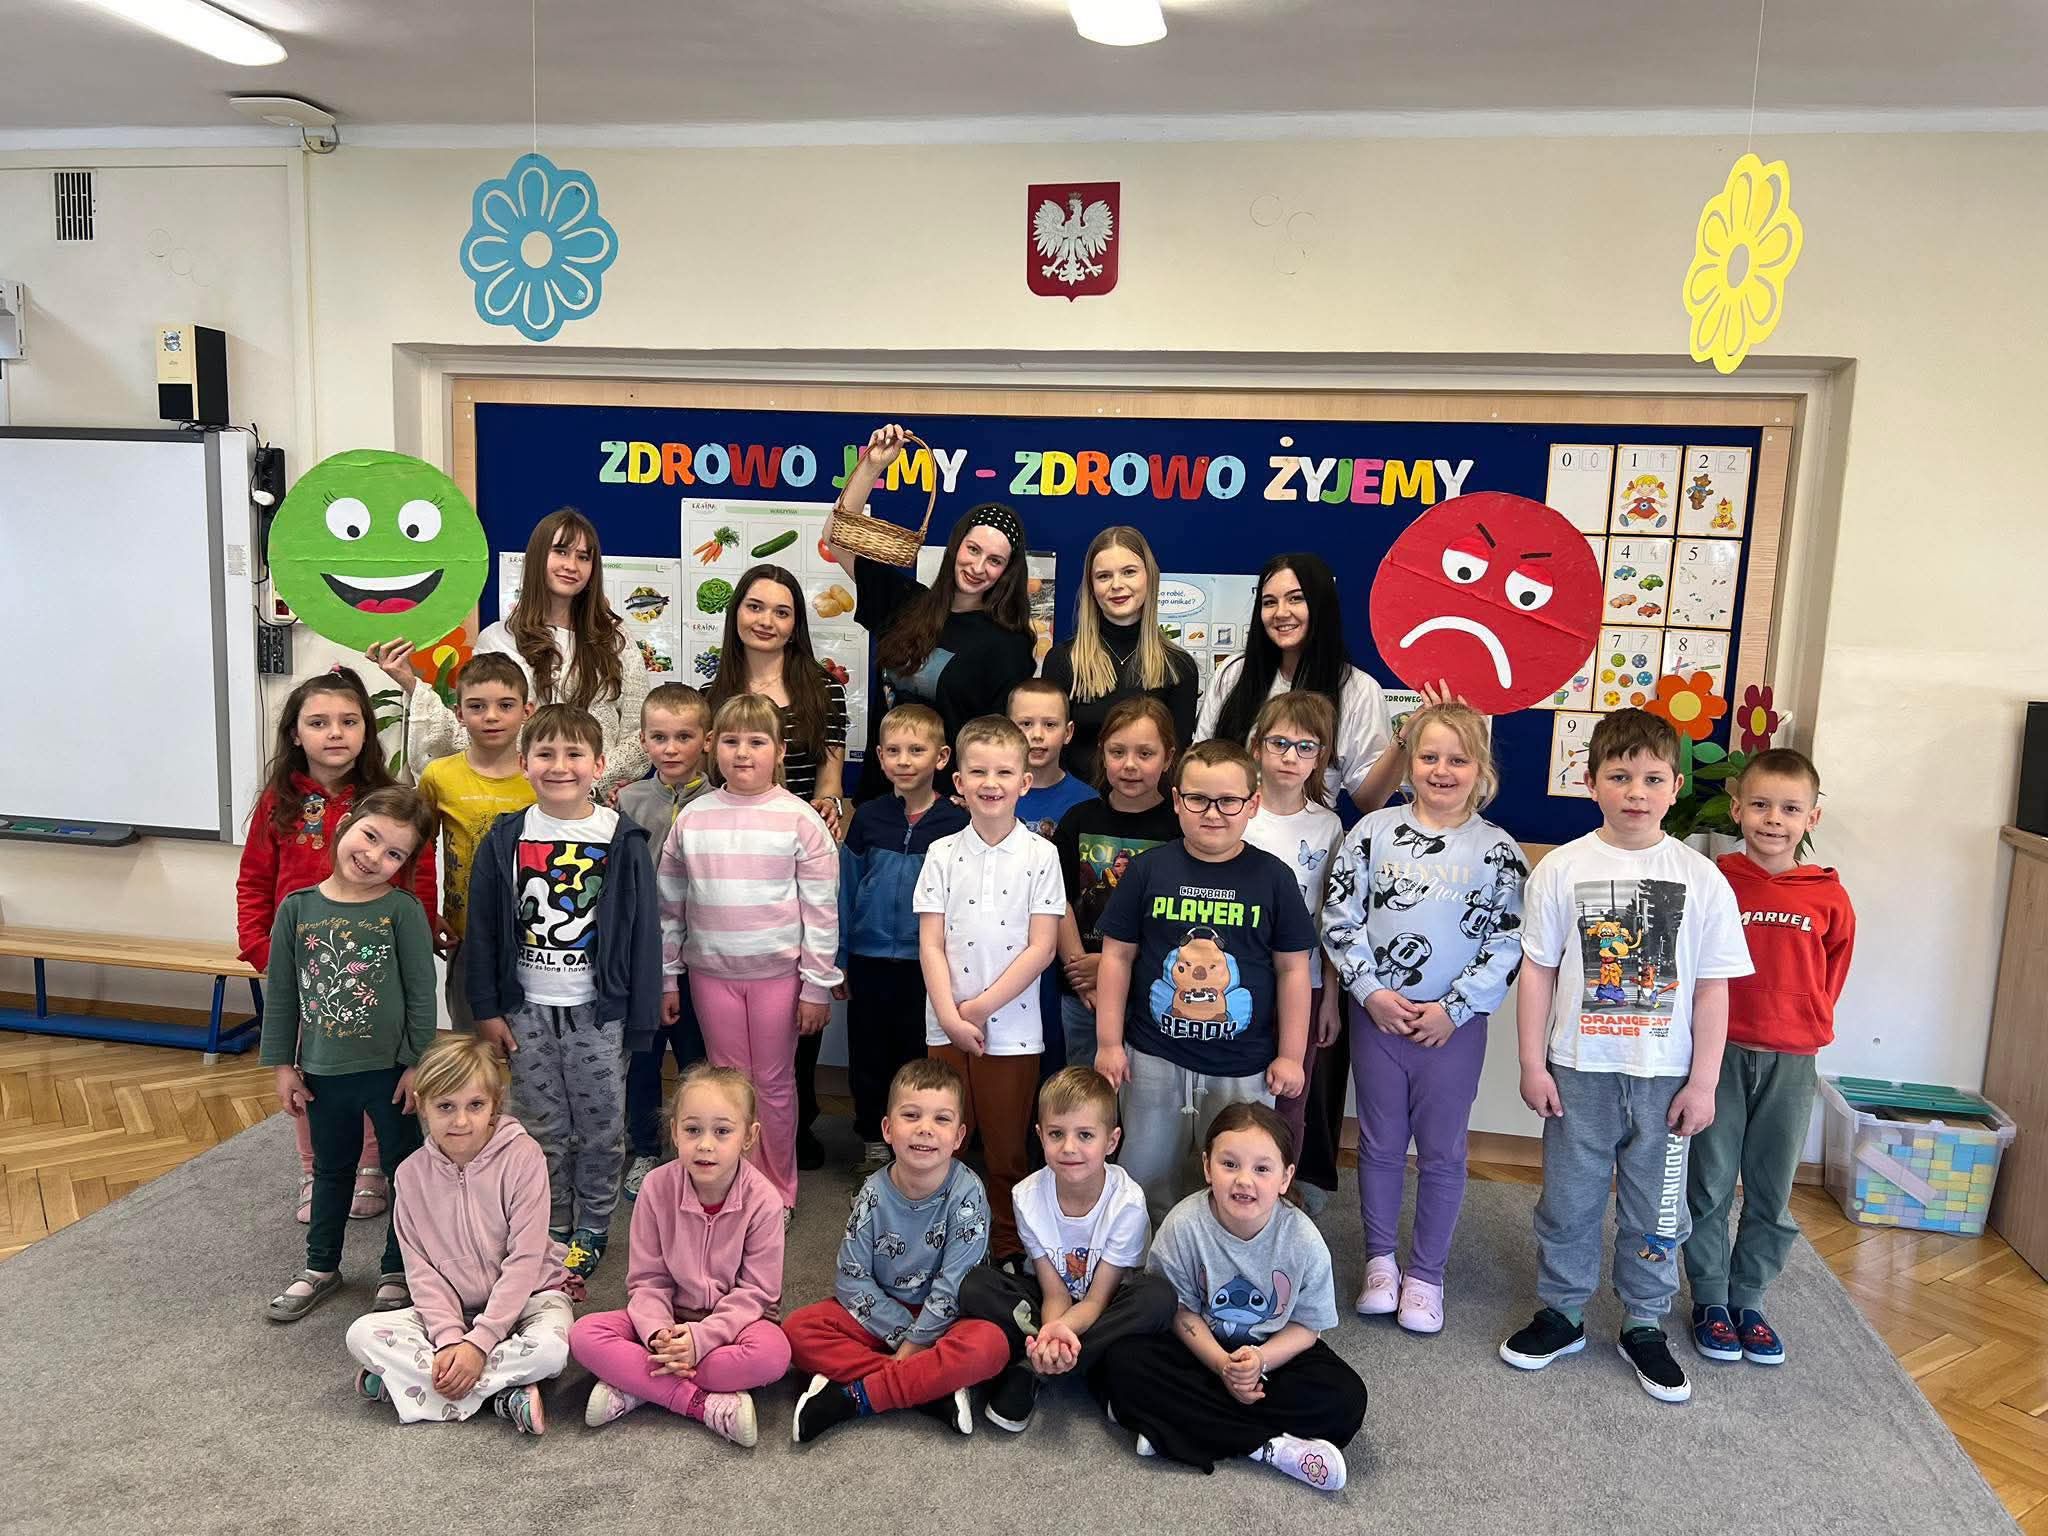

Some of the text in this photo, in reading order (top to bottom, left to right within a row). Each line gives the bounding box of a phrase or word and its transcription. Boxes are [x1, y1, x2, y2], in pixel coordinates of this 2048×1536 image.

[1562, 452, 1572, 467] 0
[1631, 453, 1638, 467] 1
[1698, 454, 1737, 471] 2 2
[599, 441, 816, 488] ZDROWO
[832, 444, 967, 492] JMY
[1009, 451, 1246, 500] ZDROWO
[1263, 436, 1474, 505] ŻYJEMY
[1621, 545, 1631, 558] 4
[1688, 547, 1698, 560] 5
[1612, 634, 1621, 648] 7
[1679, 637, 1688, 651] 8
[1384, 694, 1423, 703] ZDROWEG
[1567, 719, 1577, 733] 9
[1180, 886, 1236, 899] CAPYBARA
[1152, 896, 1261, 928] PLAYER 1
[1740, 911, 1812, 932] MARVEL
[519, 947, 592, 966] REAL OA
[1160, 1013, 1238, 1041] READY
[1580, 1014, 1649, 1027] ORANGE
[1580, 1026, 1640, 1037] ISSUES
[1655, 1133, 1684, 1239] PADDINGTON
